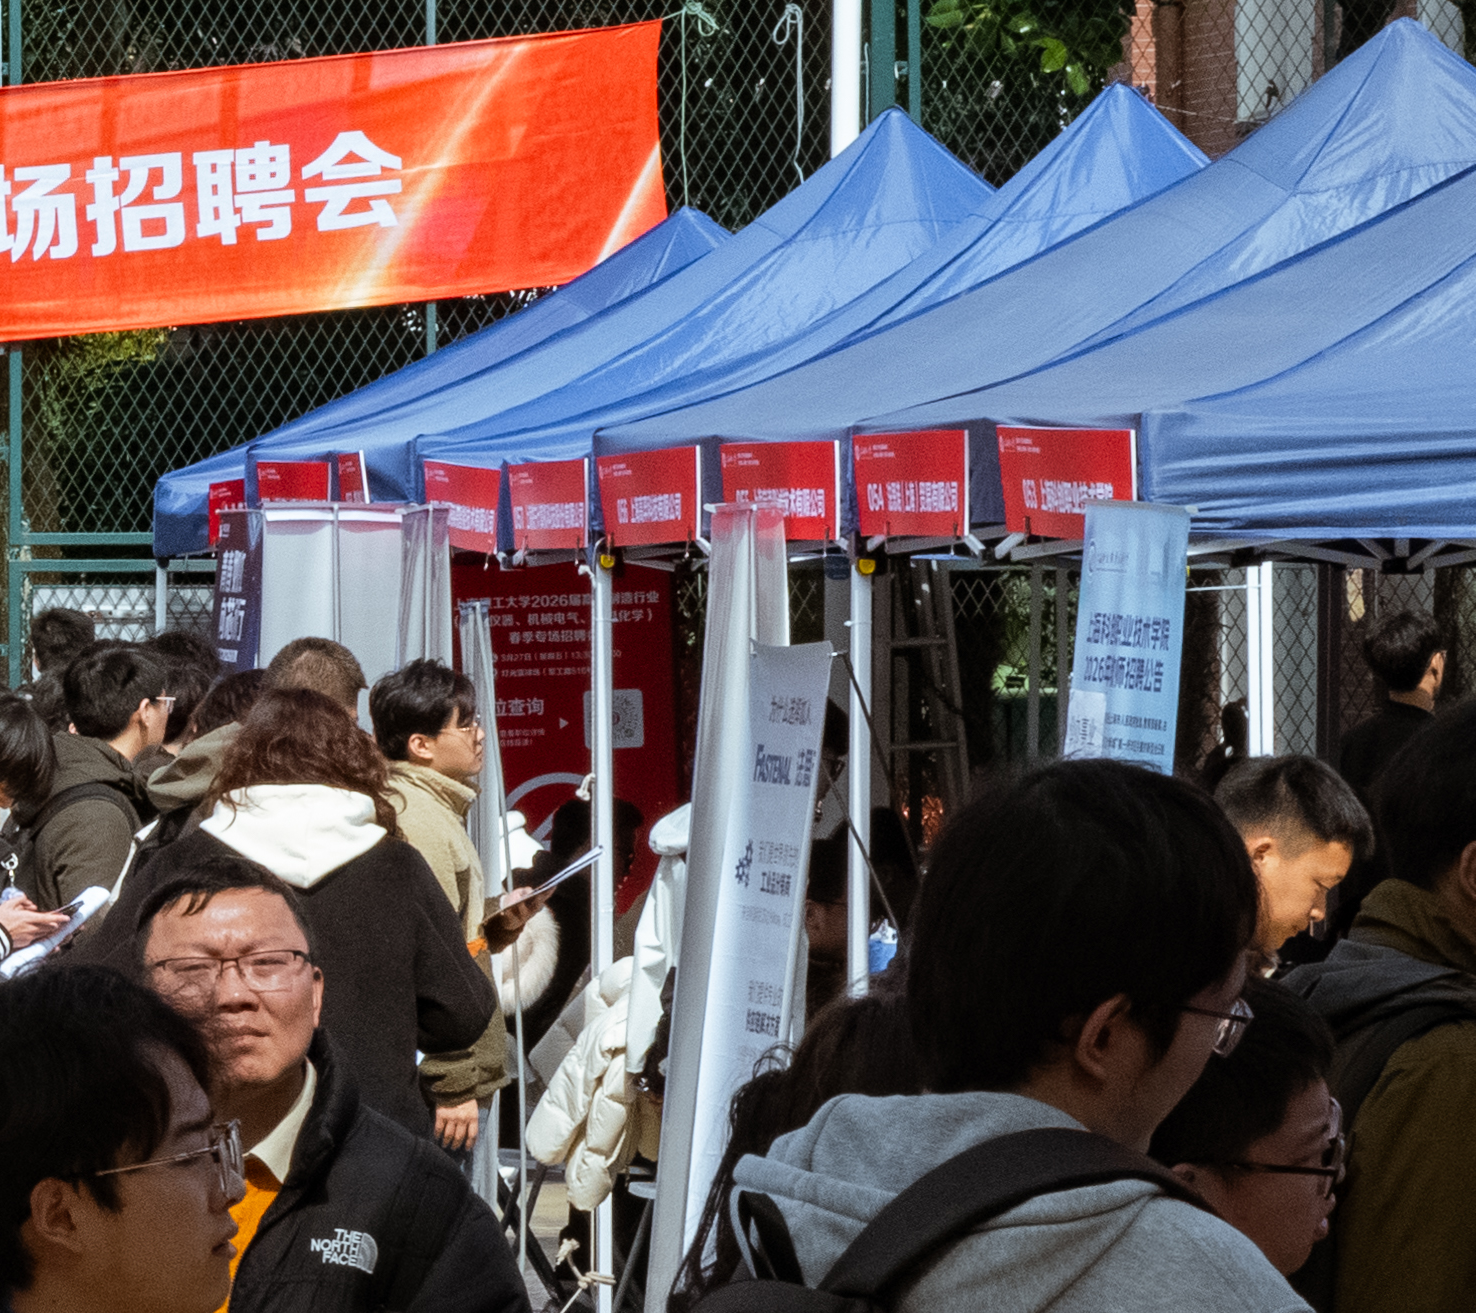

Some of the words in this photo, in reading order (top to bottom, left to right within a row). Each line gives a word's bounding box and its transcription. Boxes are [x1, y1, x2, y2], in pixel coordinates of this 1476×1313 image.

[753, 743, 792, 785] FASTENAL
[334, 1228, 363, 1245] THE
[310, 1238, 360, 1258] NORTH
[322, 1251, 358, 1267] FACE
